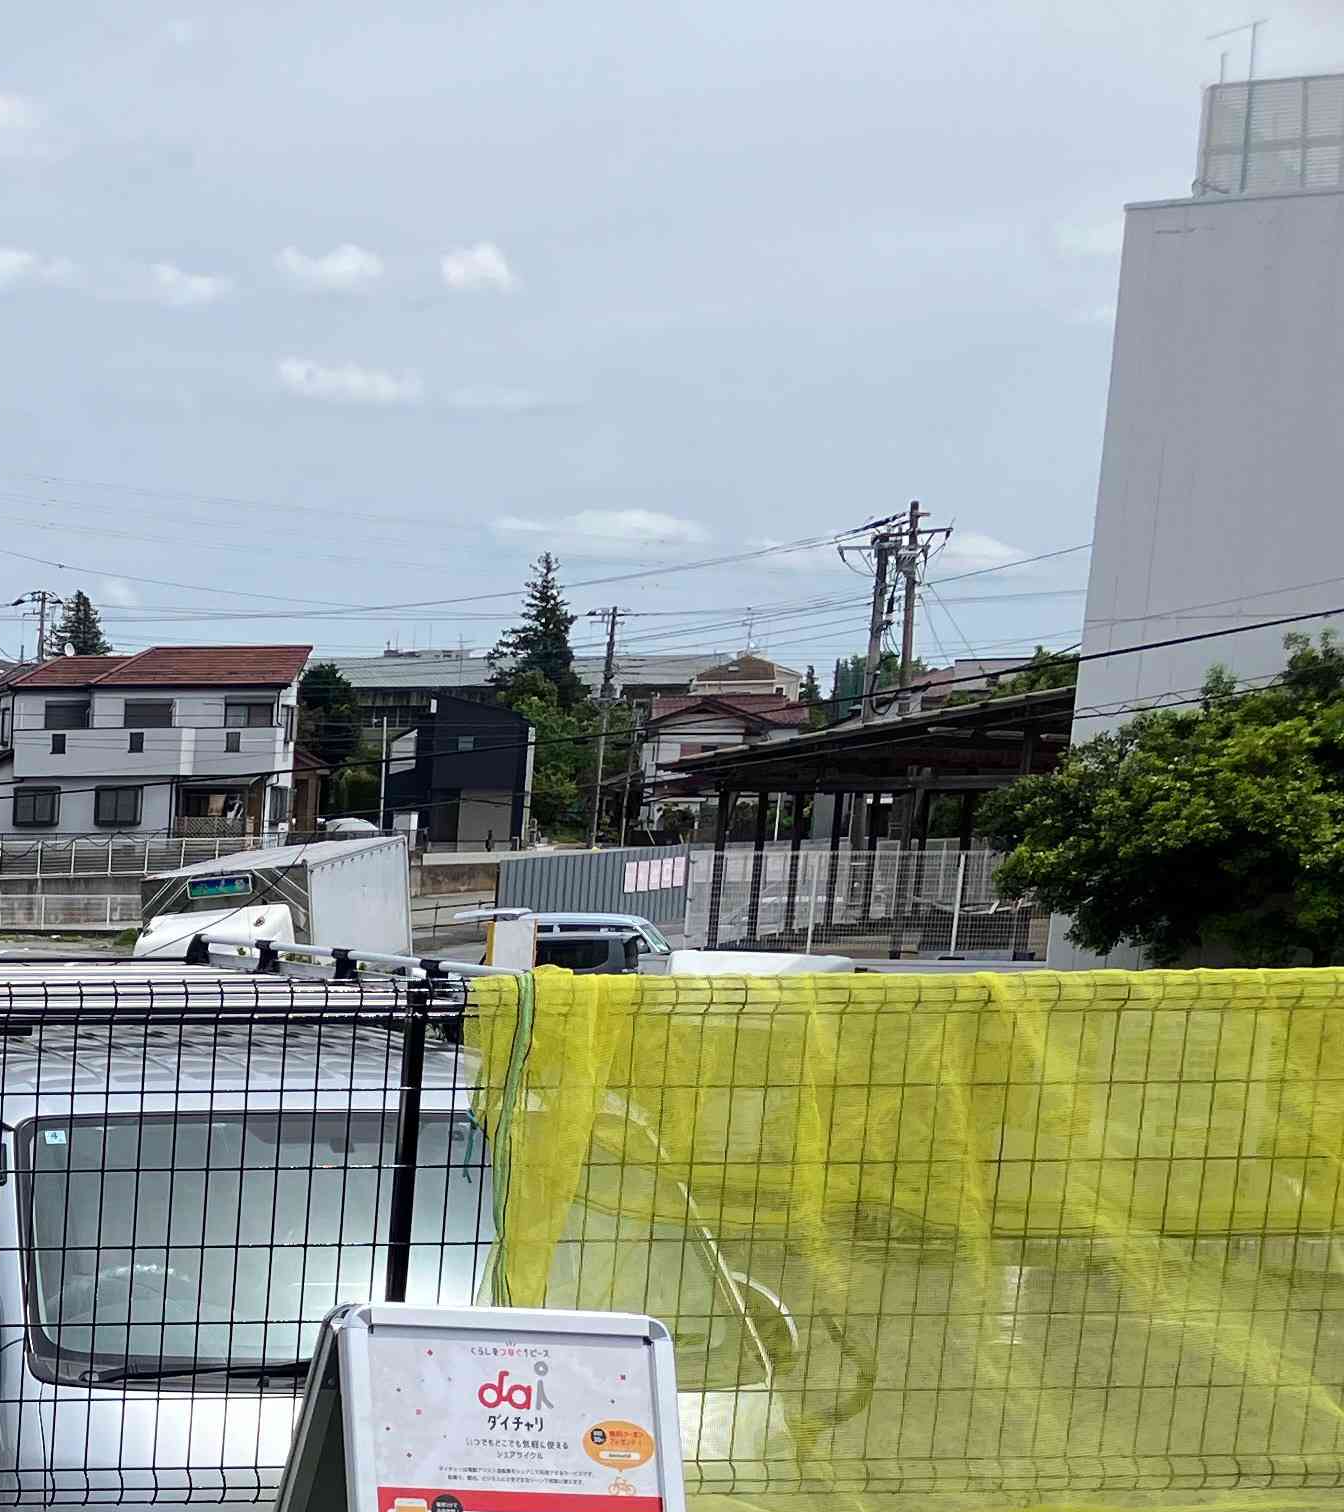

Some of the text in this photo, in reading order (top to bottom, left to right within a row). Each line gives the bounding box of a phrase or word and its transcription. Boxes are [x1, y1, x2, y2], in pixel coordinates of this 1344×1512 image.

[488, 1414, 544, 1432] ダイチャリ
[465, 1438, 569, 1450] いつでもどこでも気軽に使える
[496, 1451, 544, 1460] シェアサイクル
